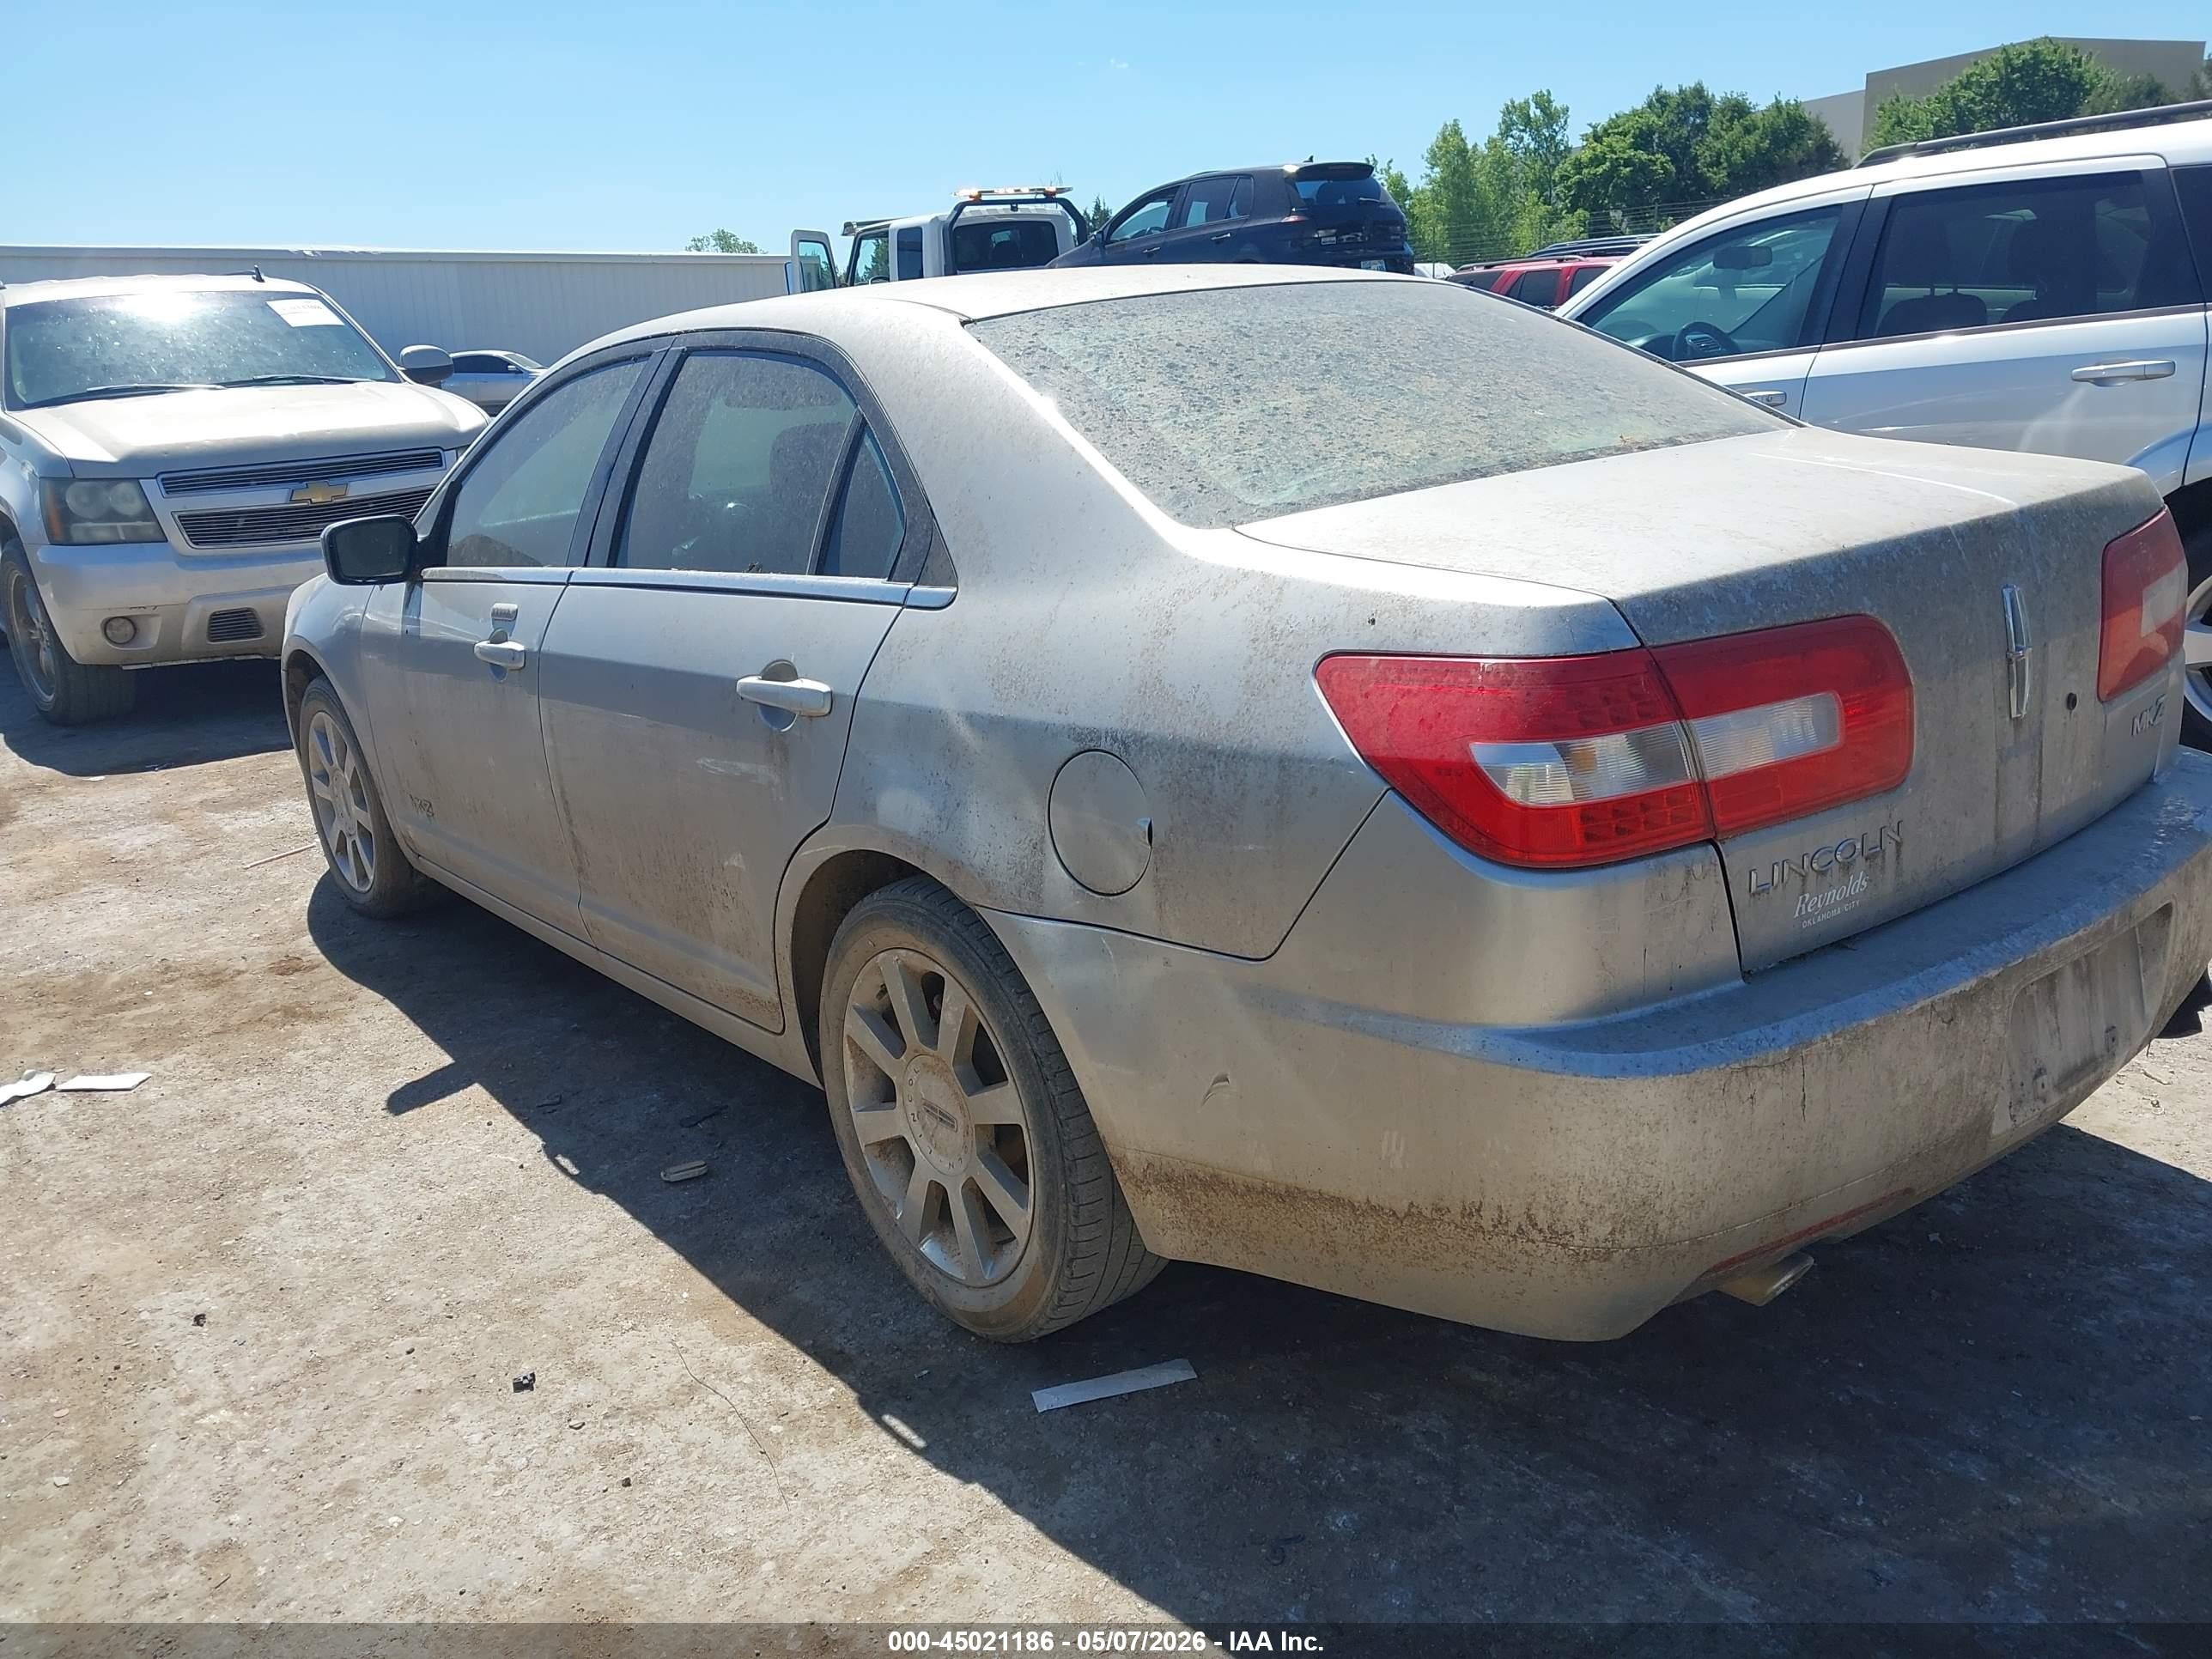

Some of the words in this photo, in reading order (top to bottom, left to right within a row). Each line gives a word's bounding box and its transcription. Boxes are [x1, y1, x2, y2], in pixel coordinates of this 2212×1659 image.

[1748, 819, 1903, 894] LINCOLN
[1793, 870, 1869, 919] Reynolds
[1801, 908, 1842, 928] OKLAHOMA
[1844, 898, 1861, 913] CITY
